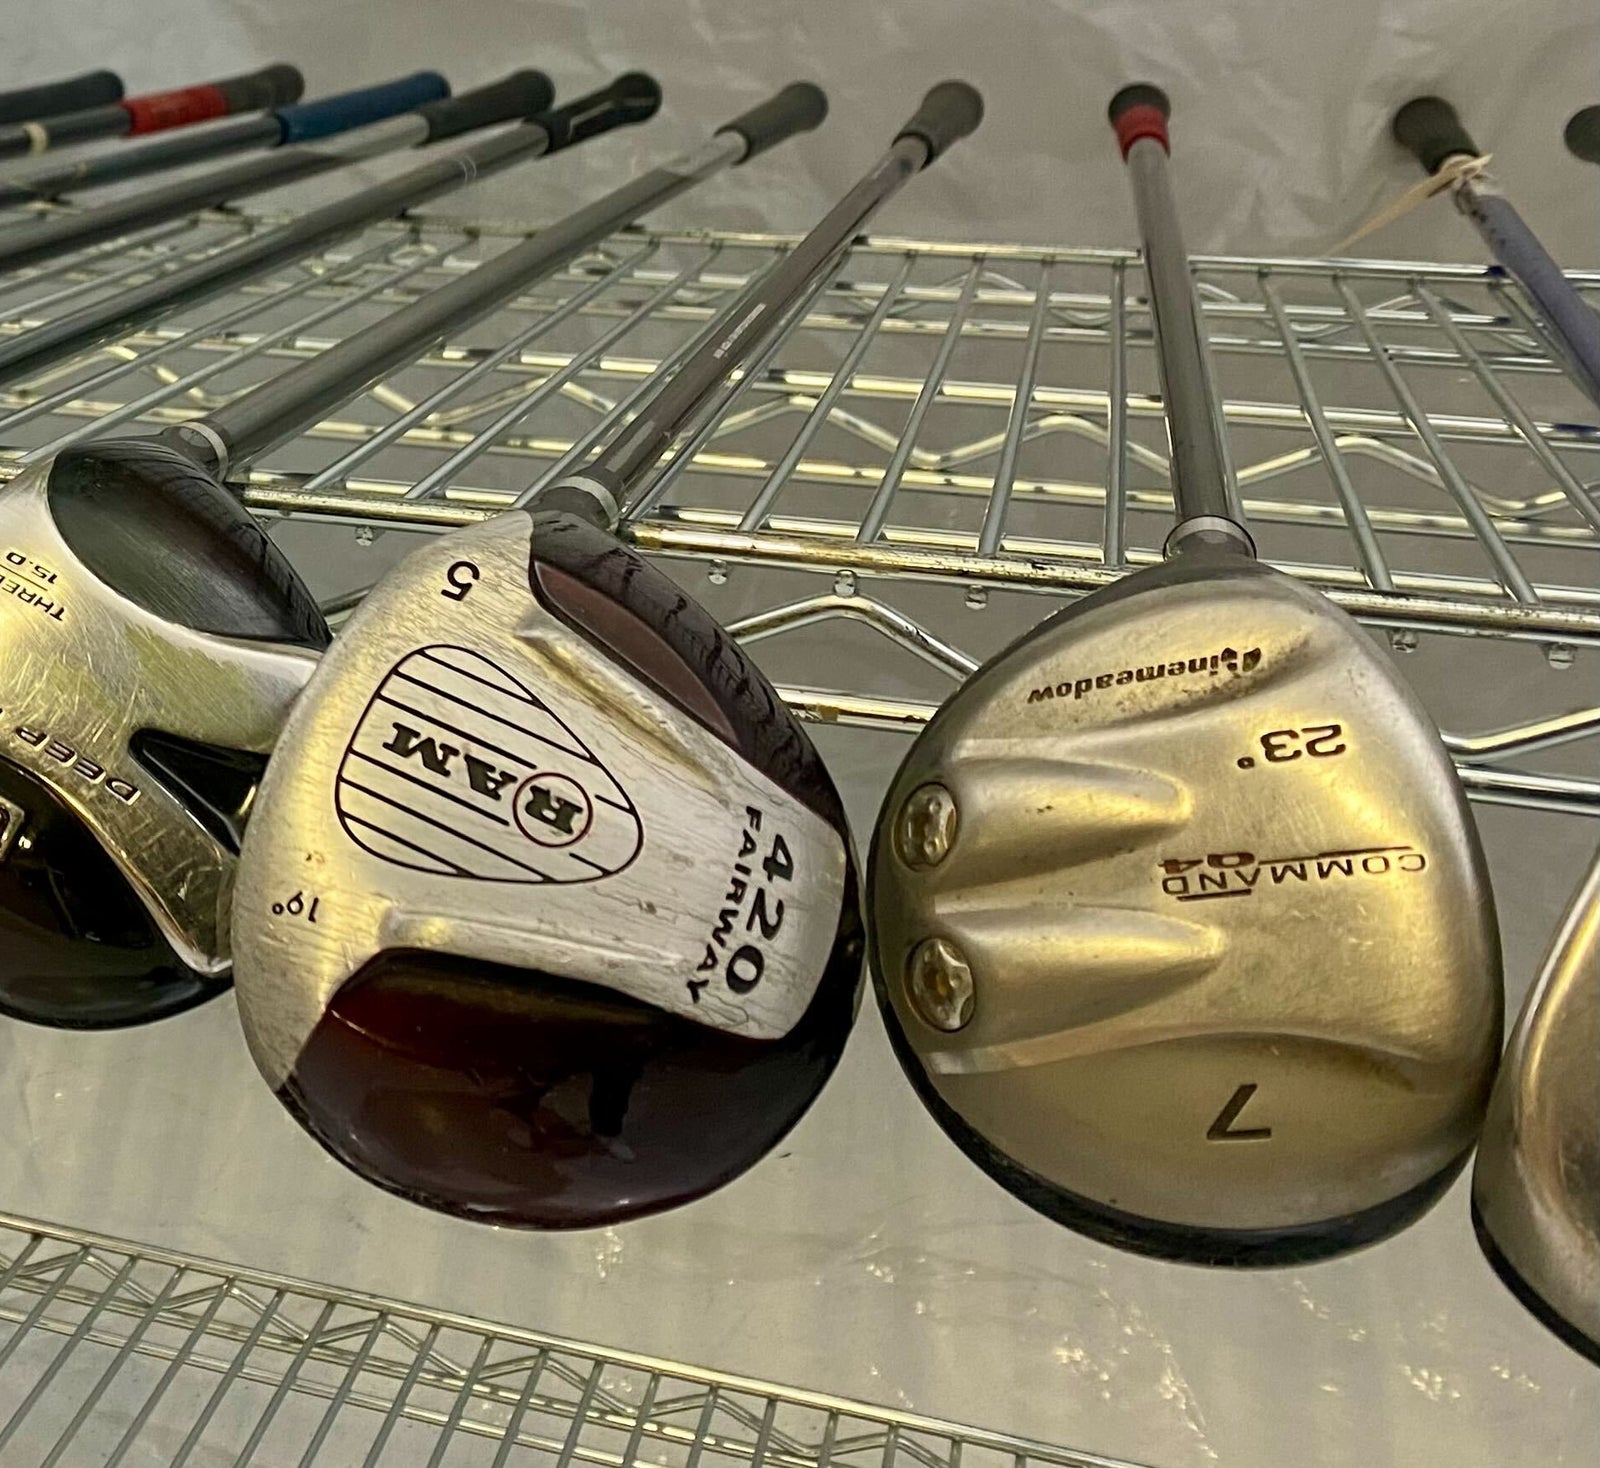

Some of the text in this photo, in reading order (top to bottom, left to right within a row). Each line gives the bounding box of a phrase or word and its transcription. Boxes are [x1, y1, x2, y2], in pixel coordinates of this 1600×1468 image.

[6, 549, 59, 585] 15.0
[439, 560, 481, 602] 5
[14, 724, 141, 805] DEEP
[381, 720, 586, 838] RAM
[685, 805, 762, 1005] FAIRWAY
[1161, 851, 1428, 897] COMMAND
[725, 831, 794, 995] 420
[1205, 1082, 1272, 1141] 7
